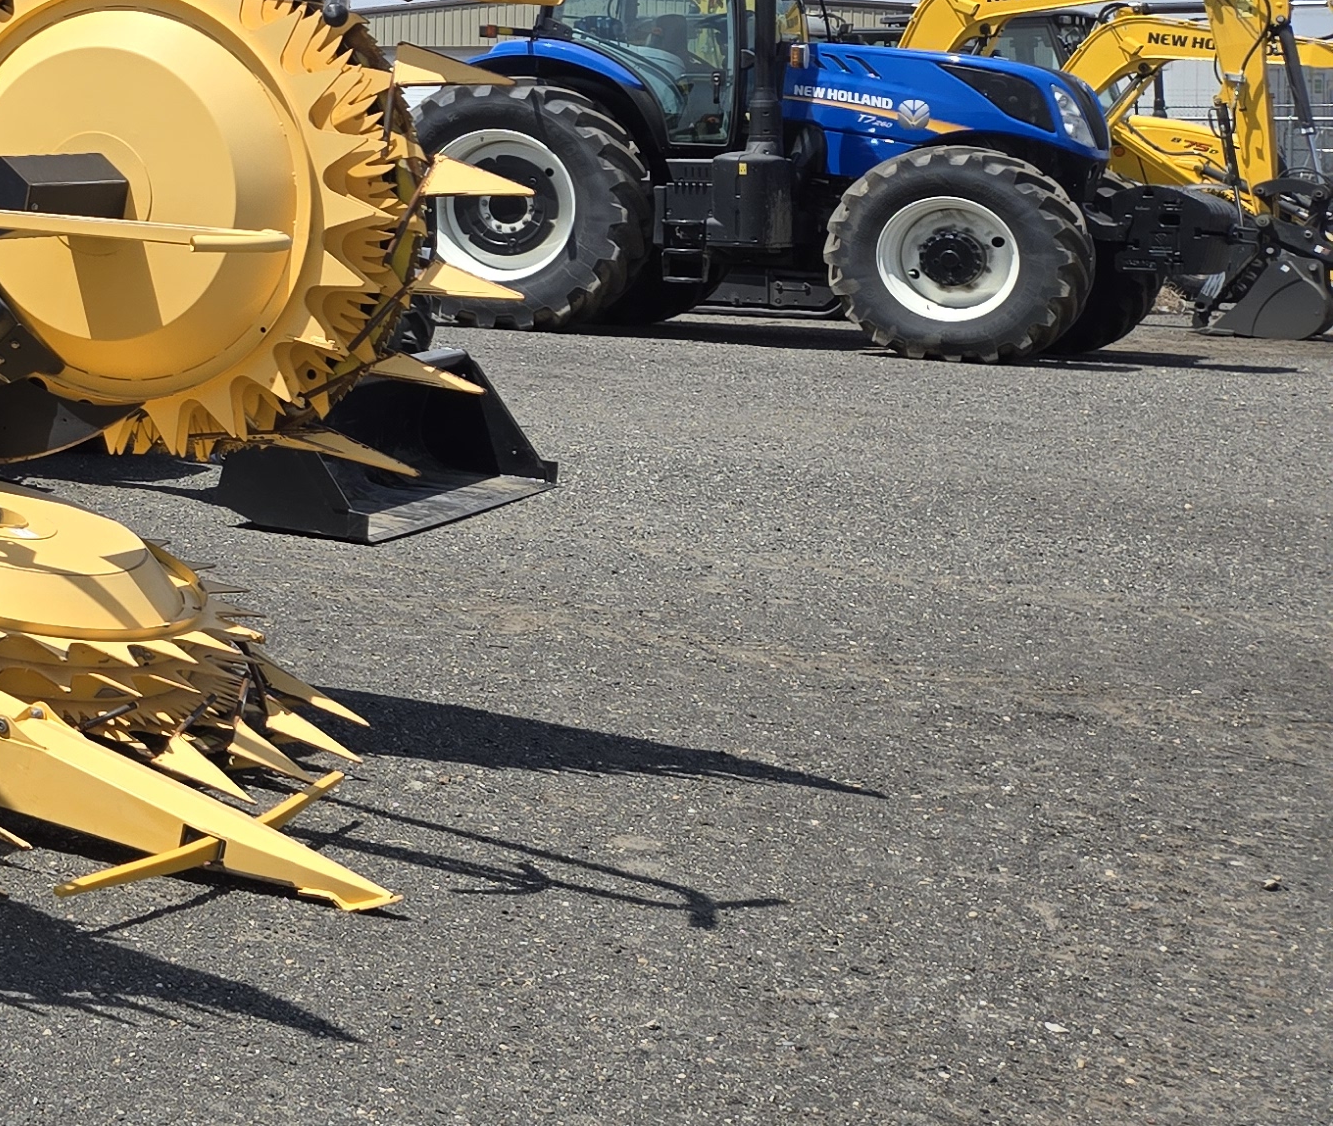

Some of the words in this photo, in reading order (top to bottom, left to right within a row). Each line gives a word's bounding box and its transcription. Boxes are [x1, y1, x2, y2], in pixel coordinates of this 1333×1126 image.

[1147, 32, 1189, 48] NEW
[793, 84, 825, 99] NEW
[826, 87, 893, 110] HOLLAND
